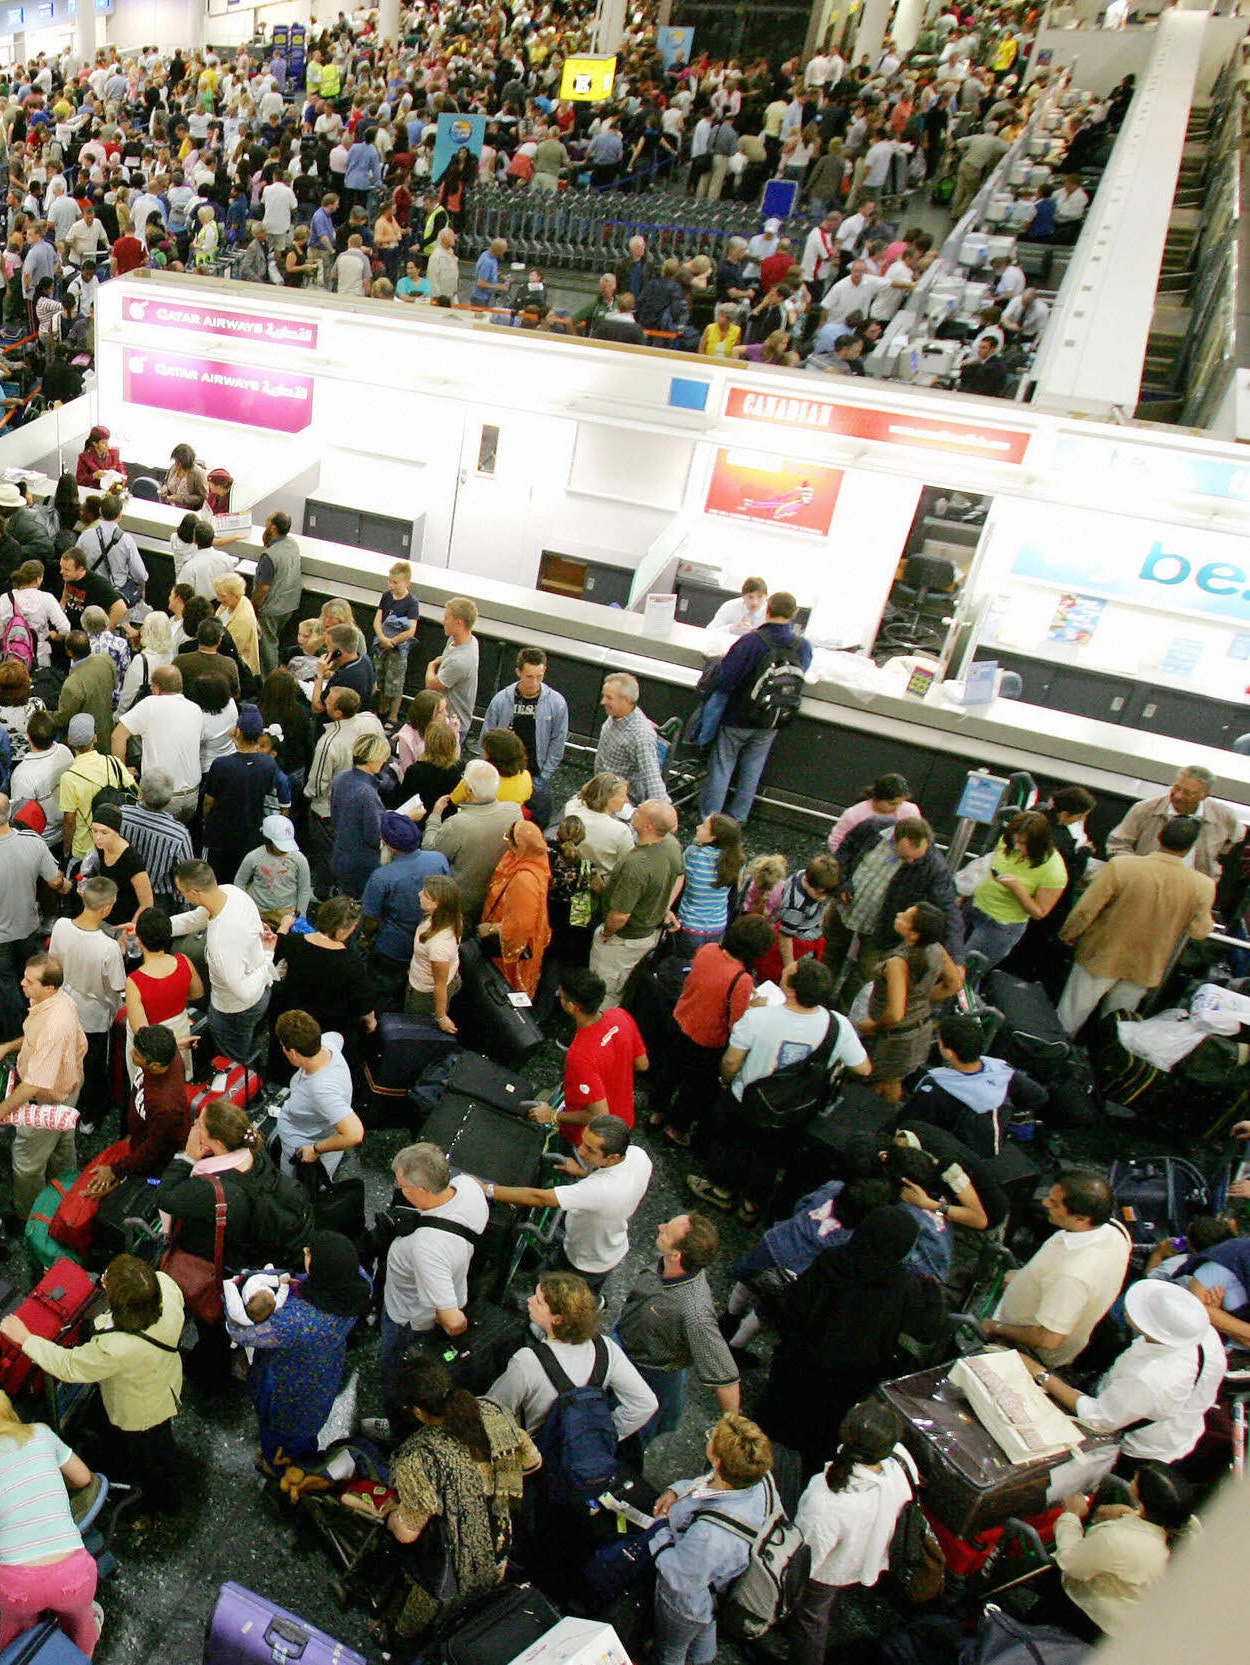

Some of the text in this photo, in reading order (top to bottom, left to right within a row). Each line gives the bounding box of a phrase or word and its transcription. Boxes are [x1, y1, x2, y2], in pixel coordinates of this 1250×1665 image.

[156, 308, 264, 335] QATAR AIRWAYS
[155, 363, 260, 391] QATAR AIRWAYS
[1139, 541, 1250, 601] be
